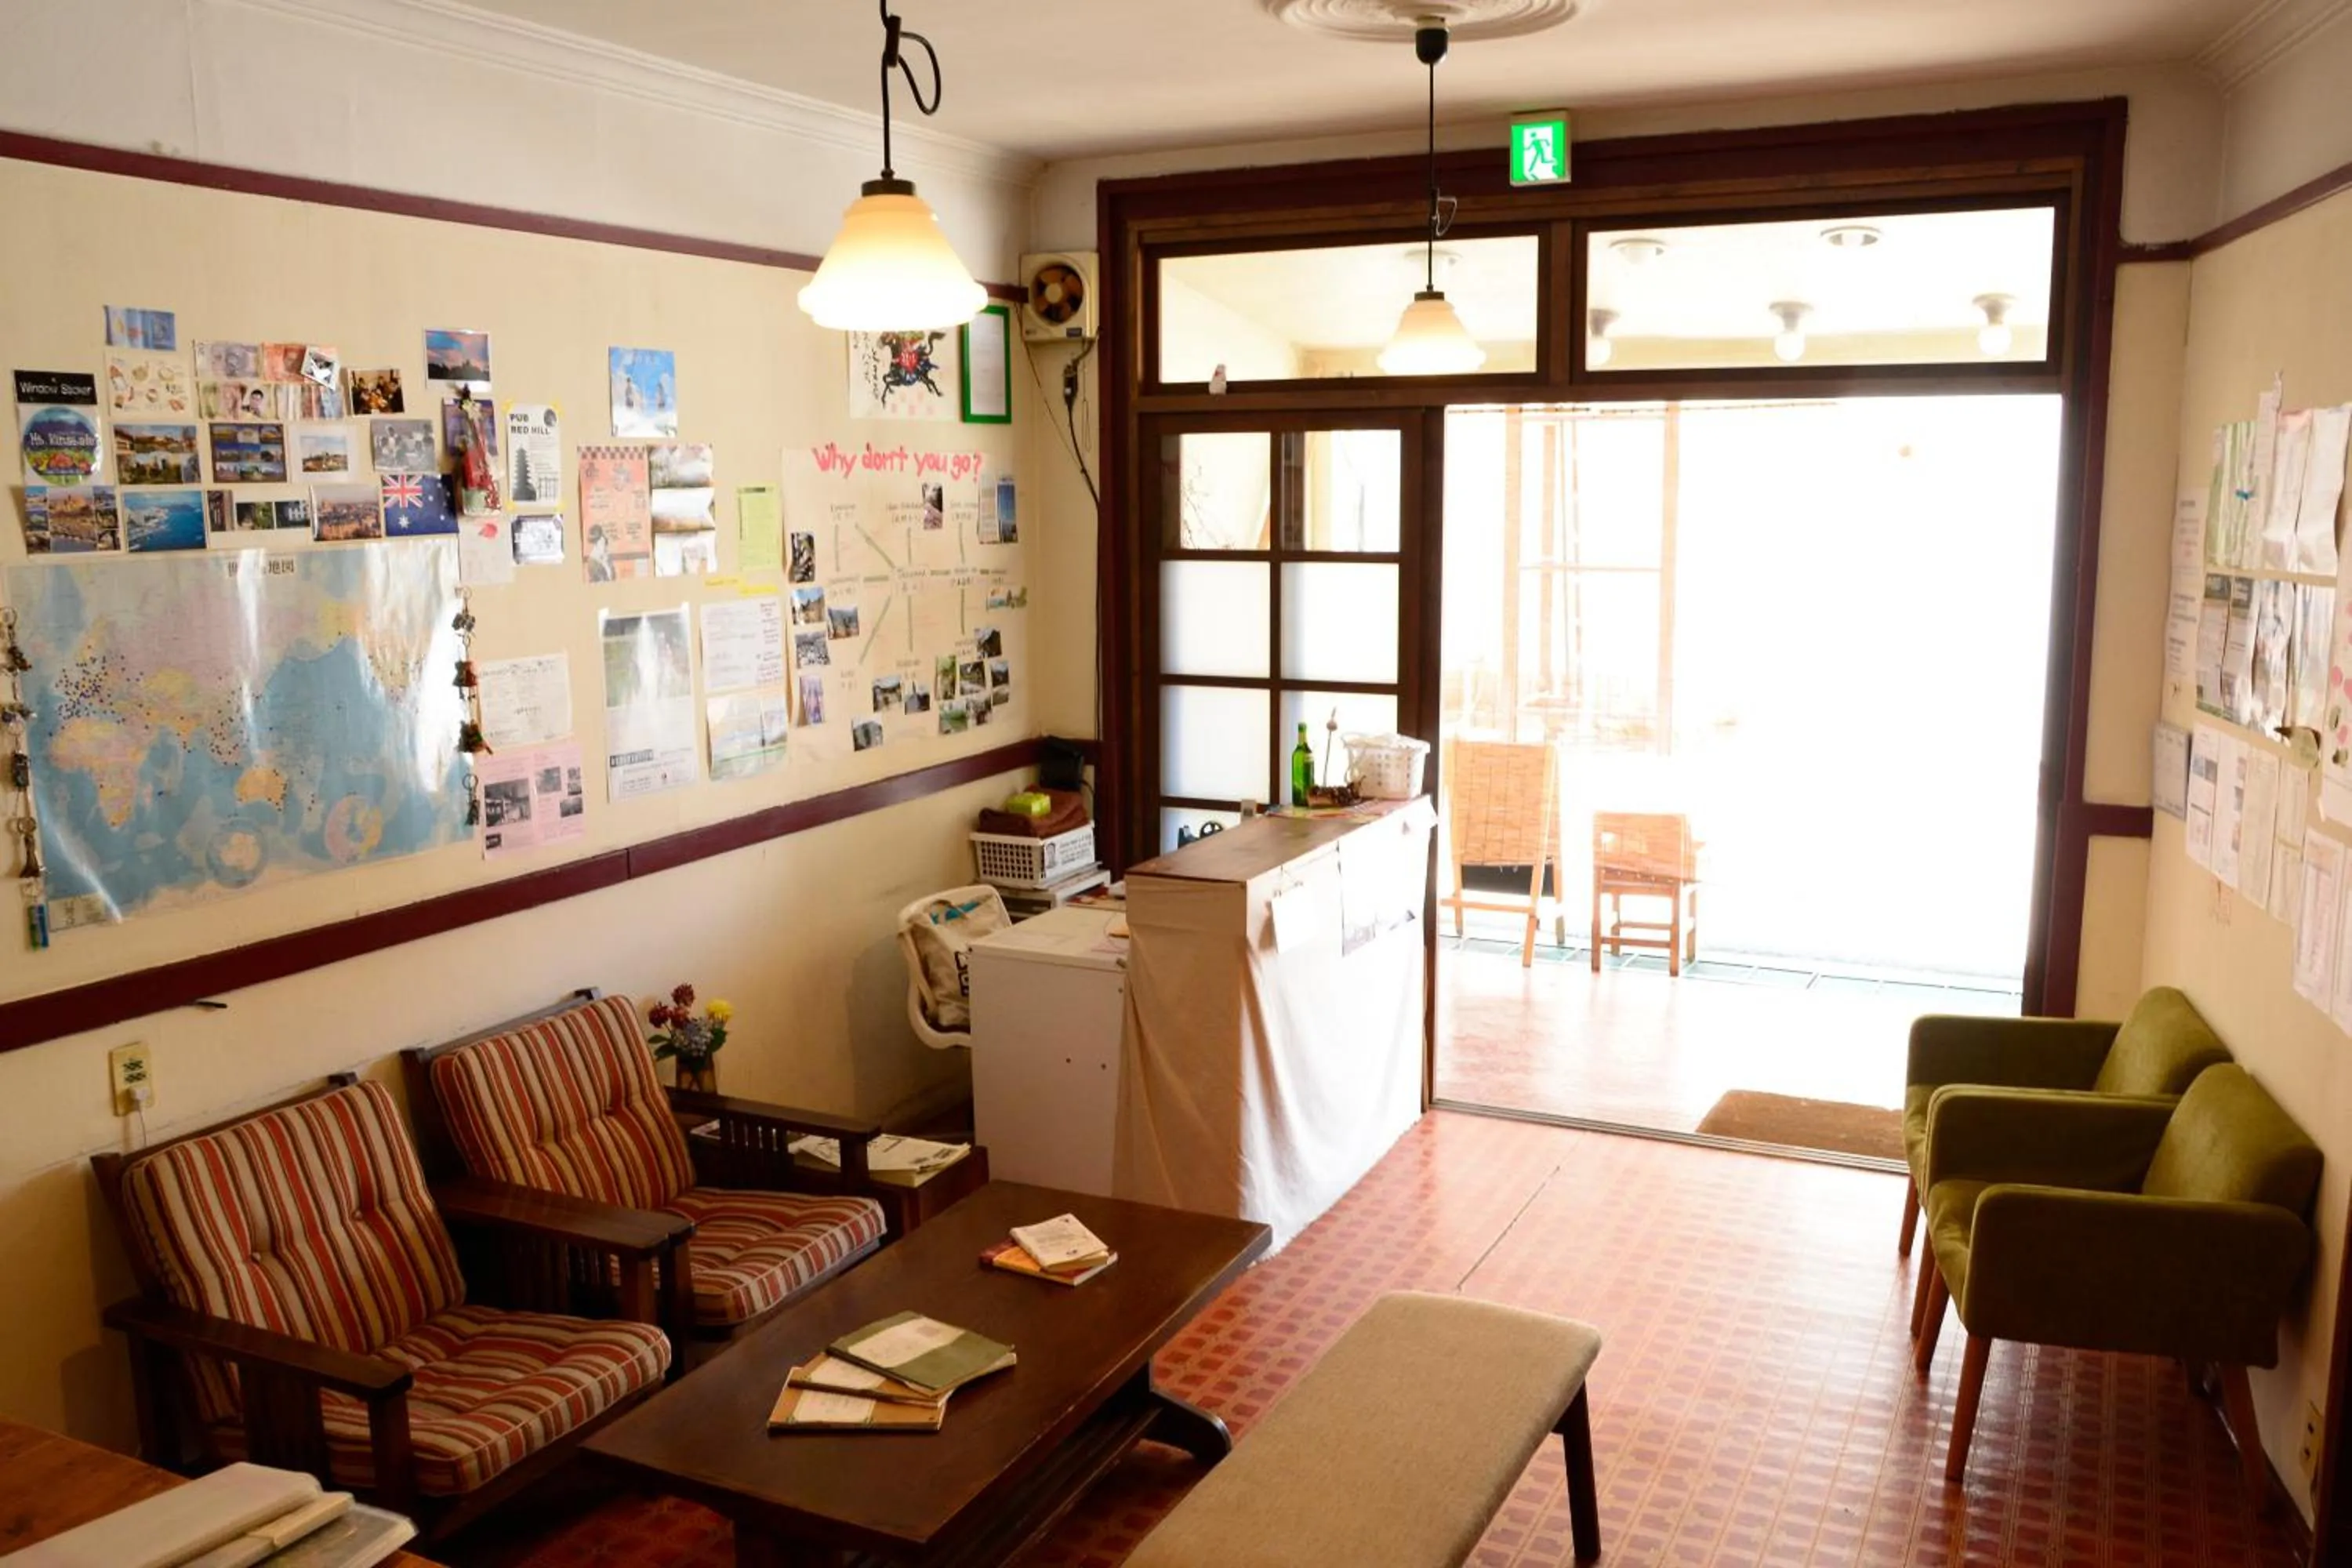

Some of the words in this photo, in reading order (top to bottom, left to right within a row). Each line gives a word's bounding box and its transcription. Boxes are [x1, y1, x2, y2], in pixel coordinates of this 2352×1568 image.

[811, 442, 856, 479] Why
[914, 452, 947, 477] you
[951, 450, 982, 482] go?
